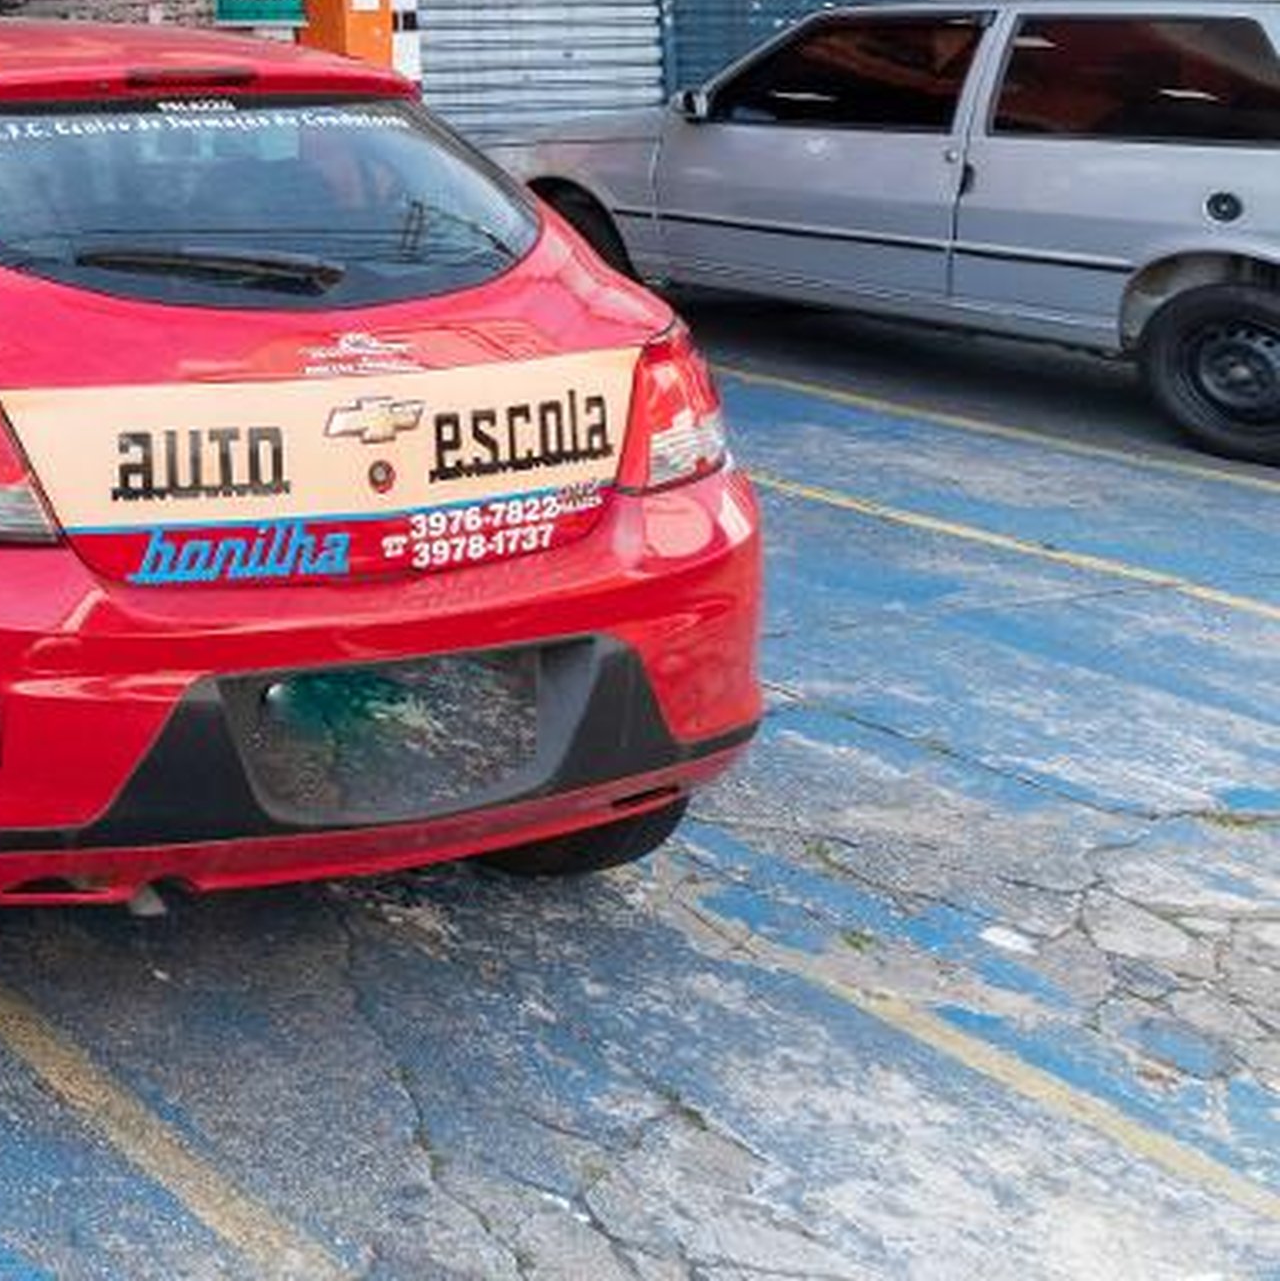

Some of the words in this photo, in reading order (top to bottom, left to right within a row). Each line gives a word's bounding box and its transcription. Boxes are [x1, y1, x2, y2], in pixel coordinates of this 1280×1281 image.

[111, 426, 290, 501] auto
[429, 389, 614, 483] escola
[410, 496, 560, 540] 3976-7822
[412, 524, 554, 568] 3978-1737
